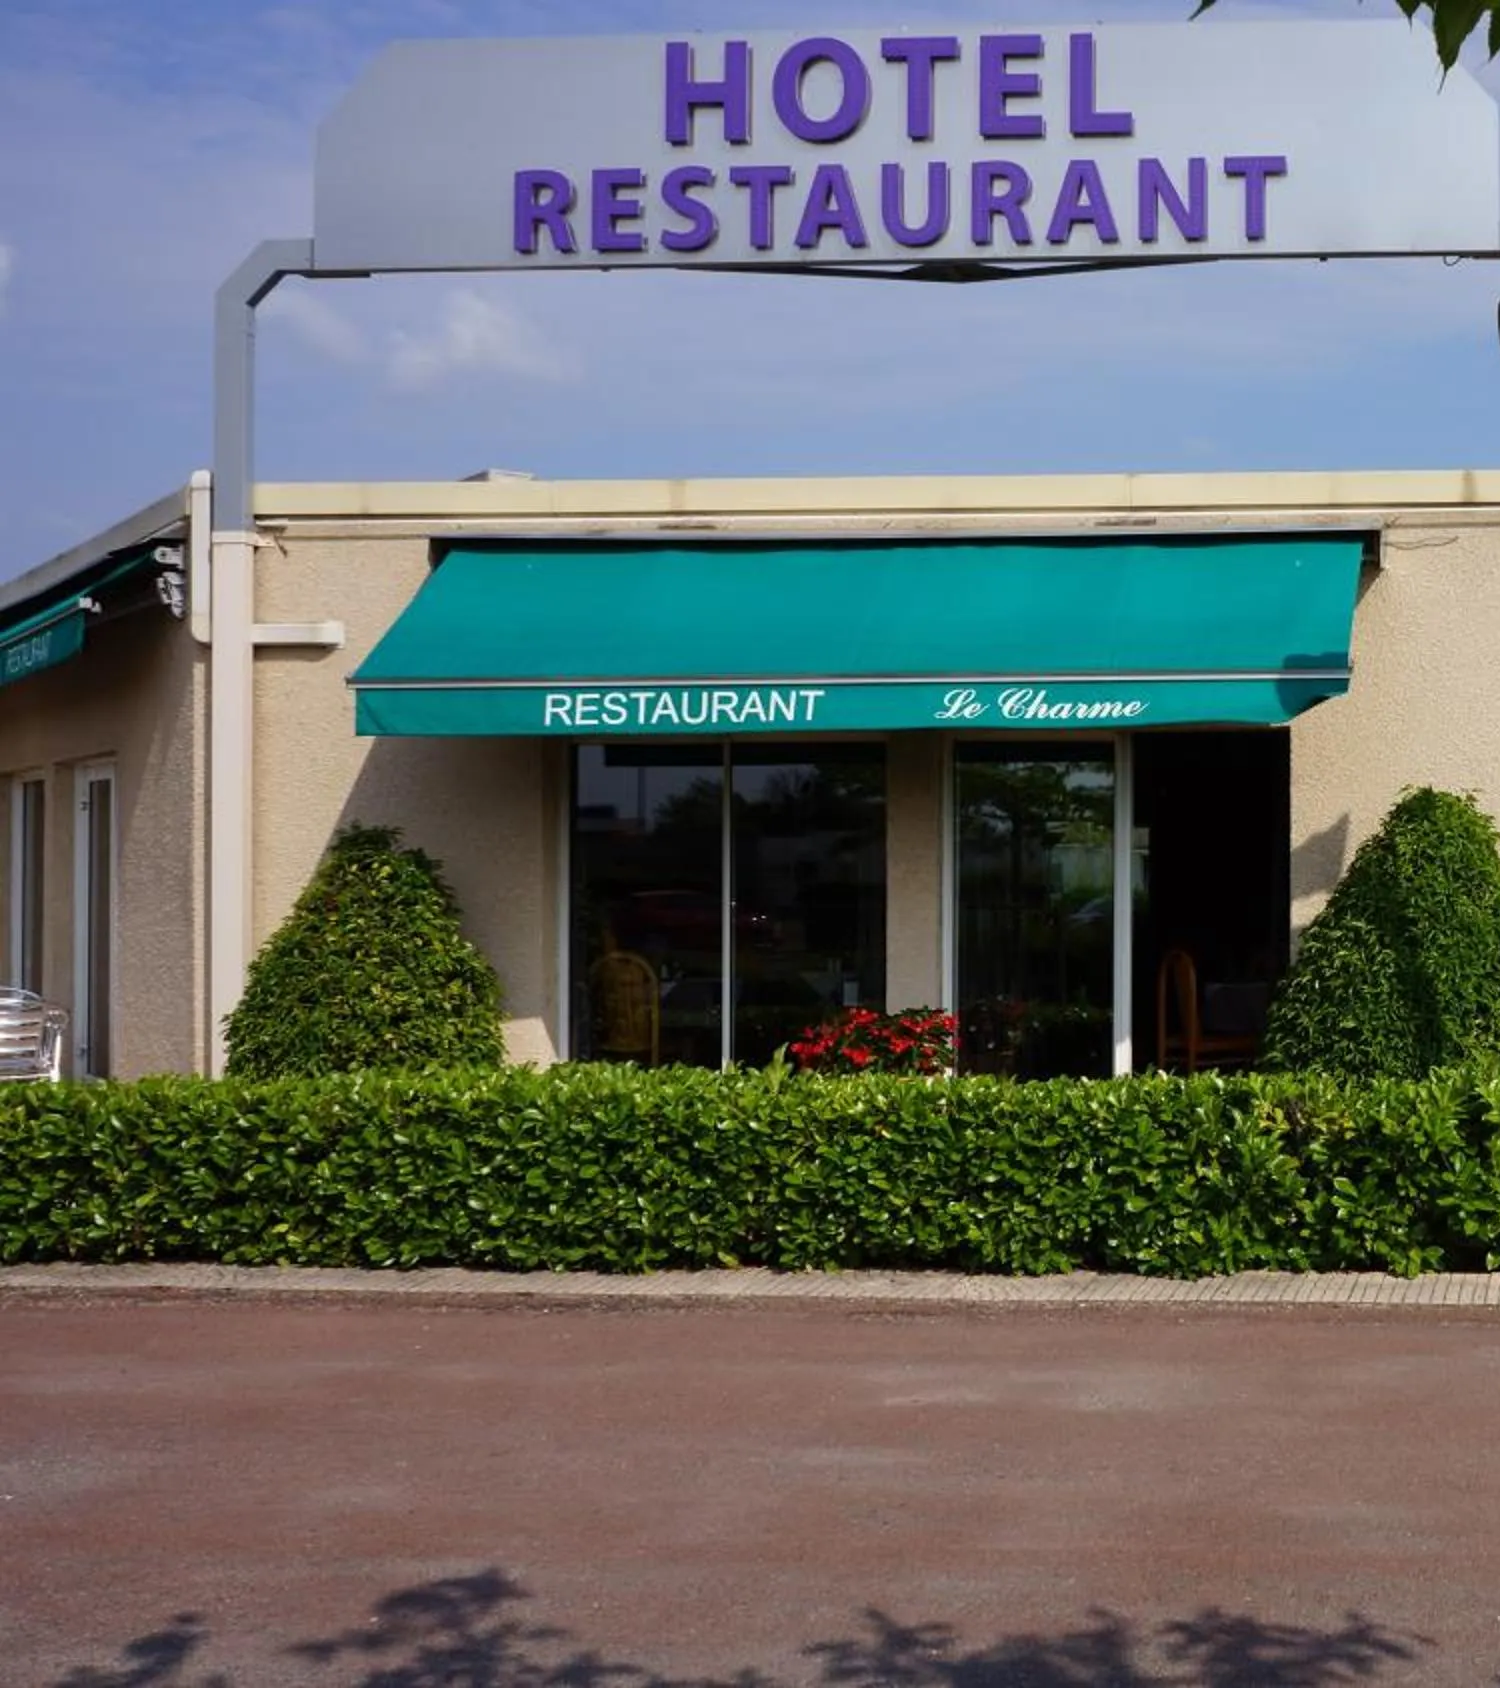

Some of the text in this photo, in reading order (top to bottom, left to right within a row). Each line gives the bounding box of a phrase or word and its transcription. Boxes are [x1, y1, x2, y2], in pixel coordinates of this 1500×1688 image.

[664, 33, 1133, 144] HOTEL
[513, 156, 1287, 254] RESTAURANT
[543, 687, 1150, 726] RESTAURANT Le Charme
